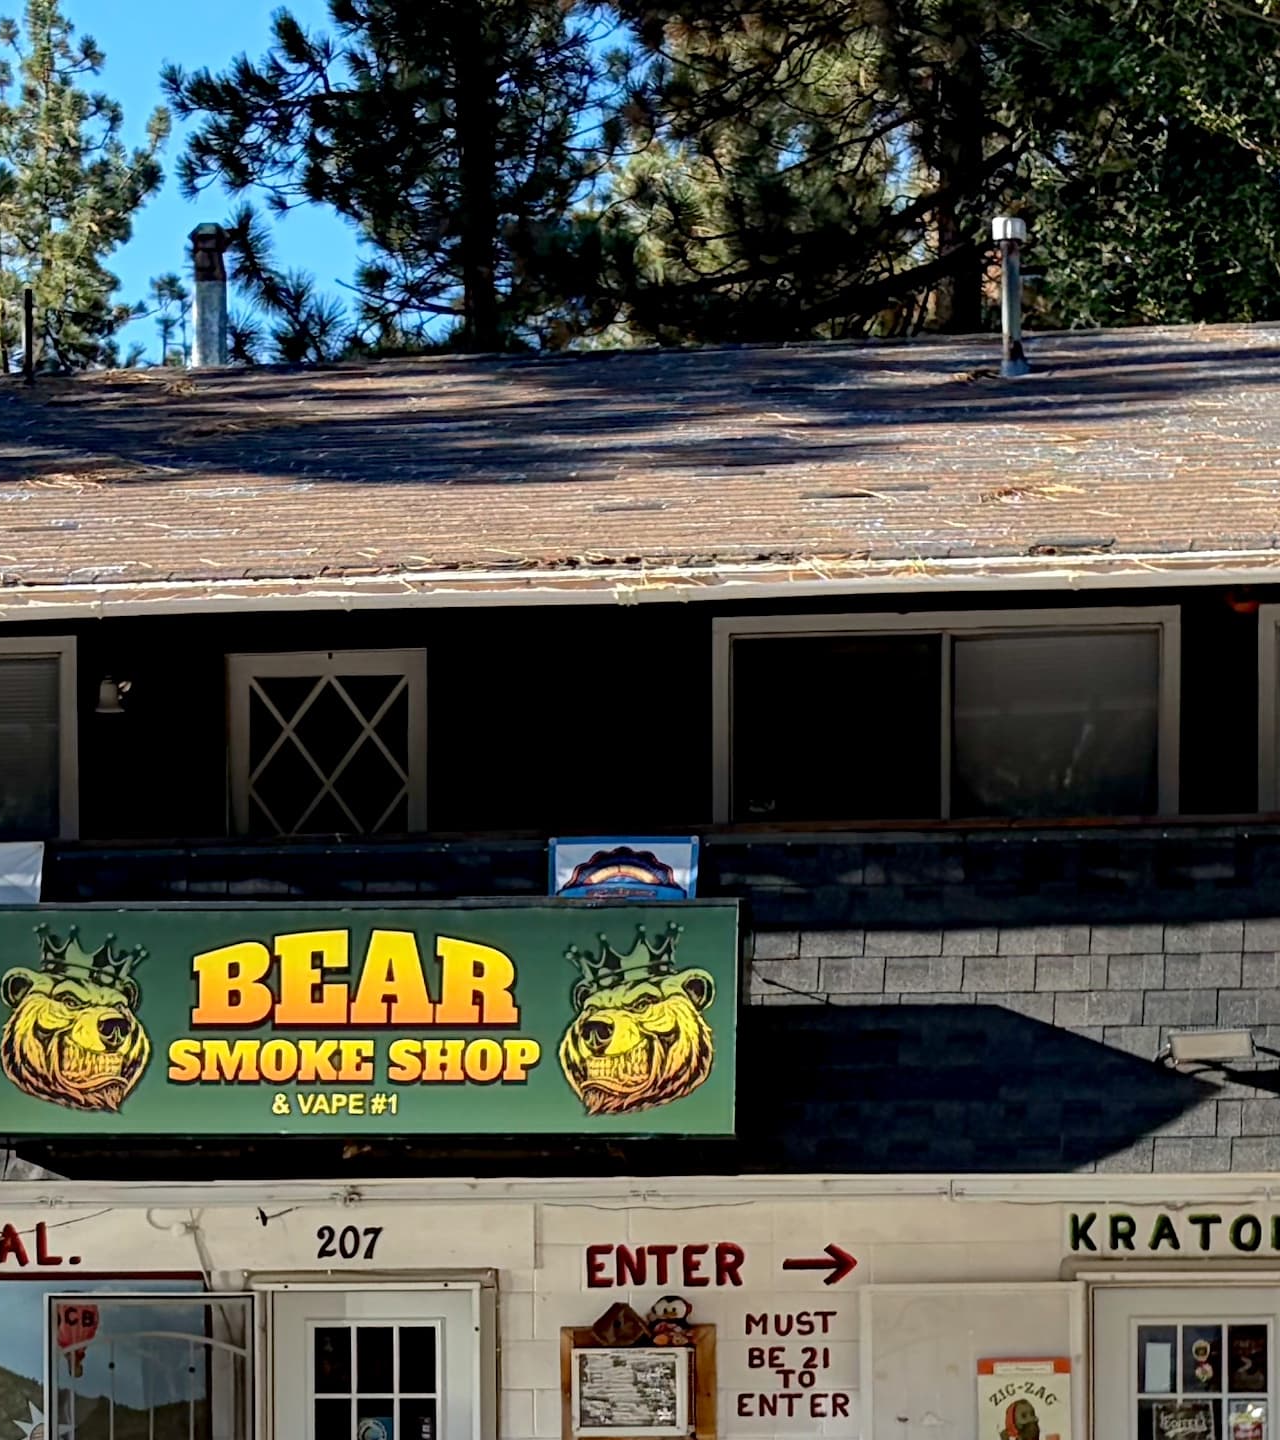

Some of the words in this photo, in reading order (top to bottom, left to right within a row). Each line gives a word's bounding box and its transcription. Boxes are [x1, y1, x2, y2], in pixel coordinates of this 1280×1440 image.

[192, 928, 520, 1025] BEAR
[168, 1038, 375, 1083] SMOKE
[386, 1038, 542, 1083] SHOP
[271, 1093, 290, 1115] &
[296, 1093, 365, 1115] VAPE
[369, 1093, 398, 1115] #1
[317, 1226, 384, 1260] 207
[587, 1242, 746, 1288] ENTER
[744, 1310, 838, 1337] MUST
[747, 1347, 785, 1369] BE
[800, 1346, 831, 1369] 21
[776, 1369, 816, 1389] TO
[737, 1392, 851, 1418] ENTER
[988, 1381, 1058, 1407] ZIG-ZAG
